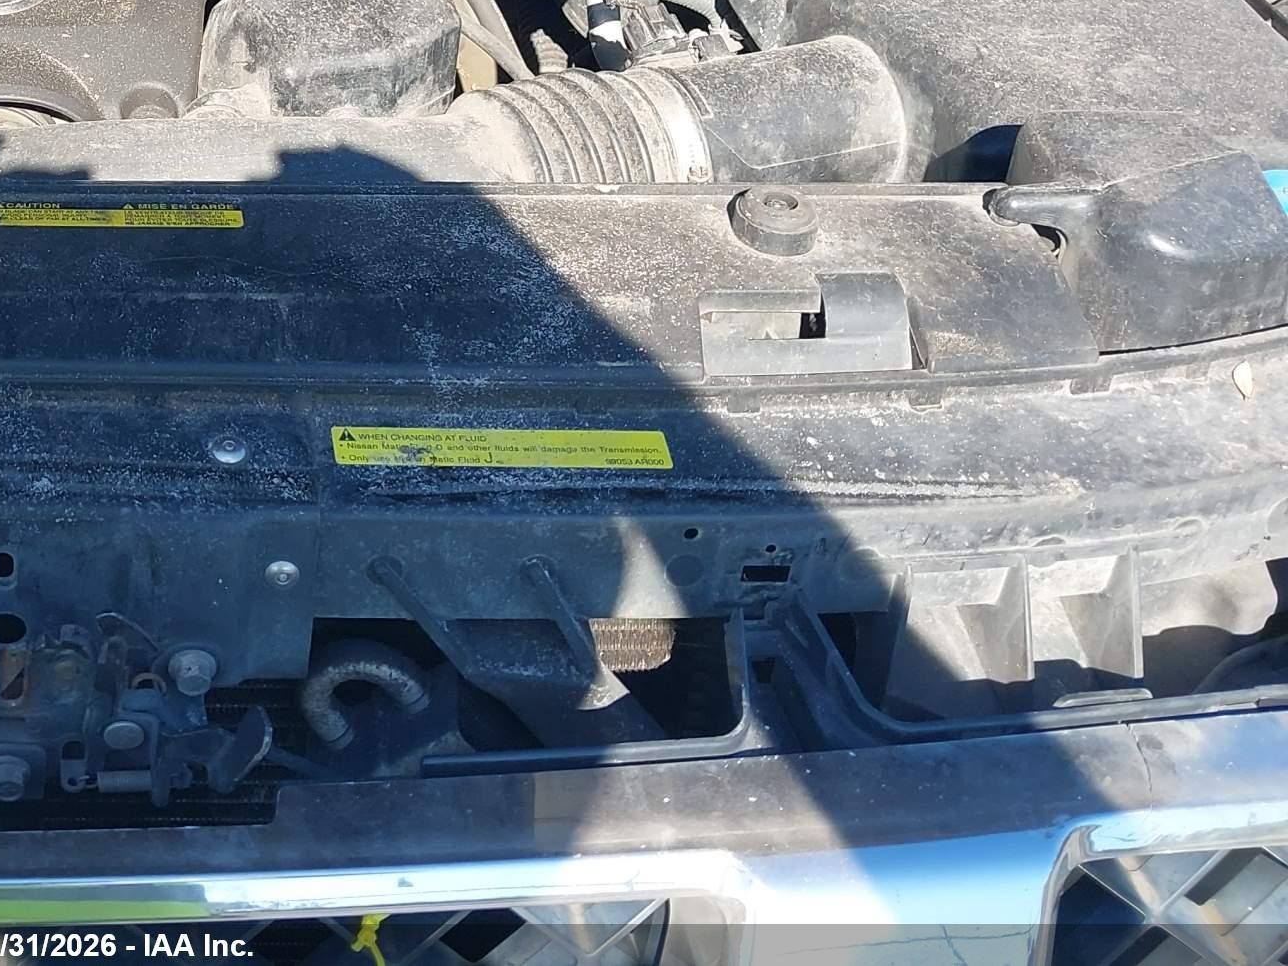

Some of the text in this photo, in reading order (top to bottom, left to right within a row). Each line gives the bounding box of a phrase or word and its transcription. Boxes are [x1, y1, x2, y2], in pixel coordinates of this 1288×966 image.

[358, 433, 388, 441] WHEN
[390, 434, 443, 442] CHANGING
[445, 434, 456, 442] AT
[347, 442, 378, 450] Nissan
[447, 444, 464, 452] and
[467, 444, 490, 452] other
